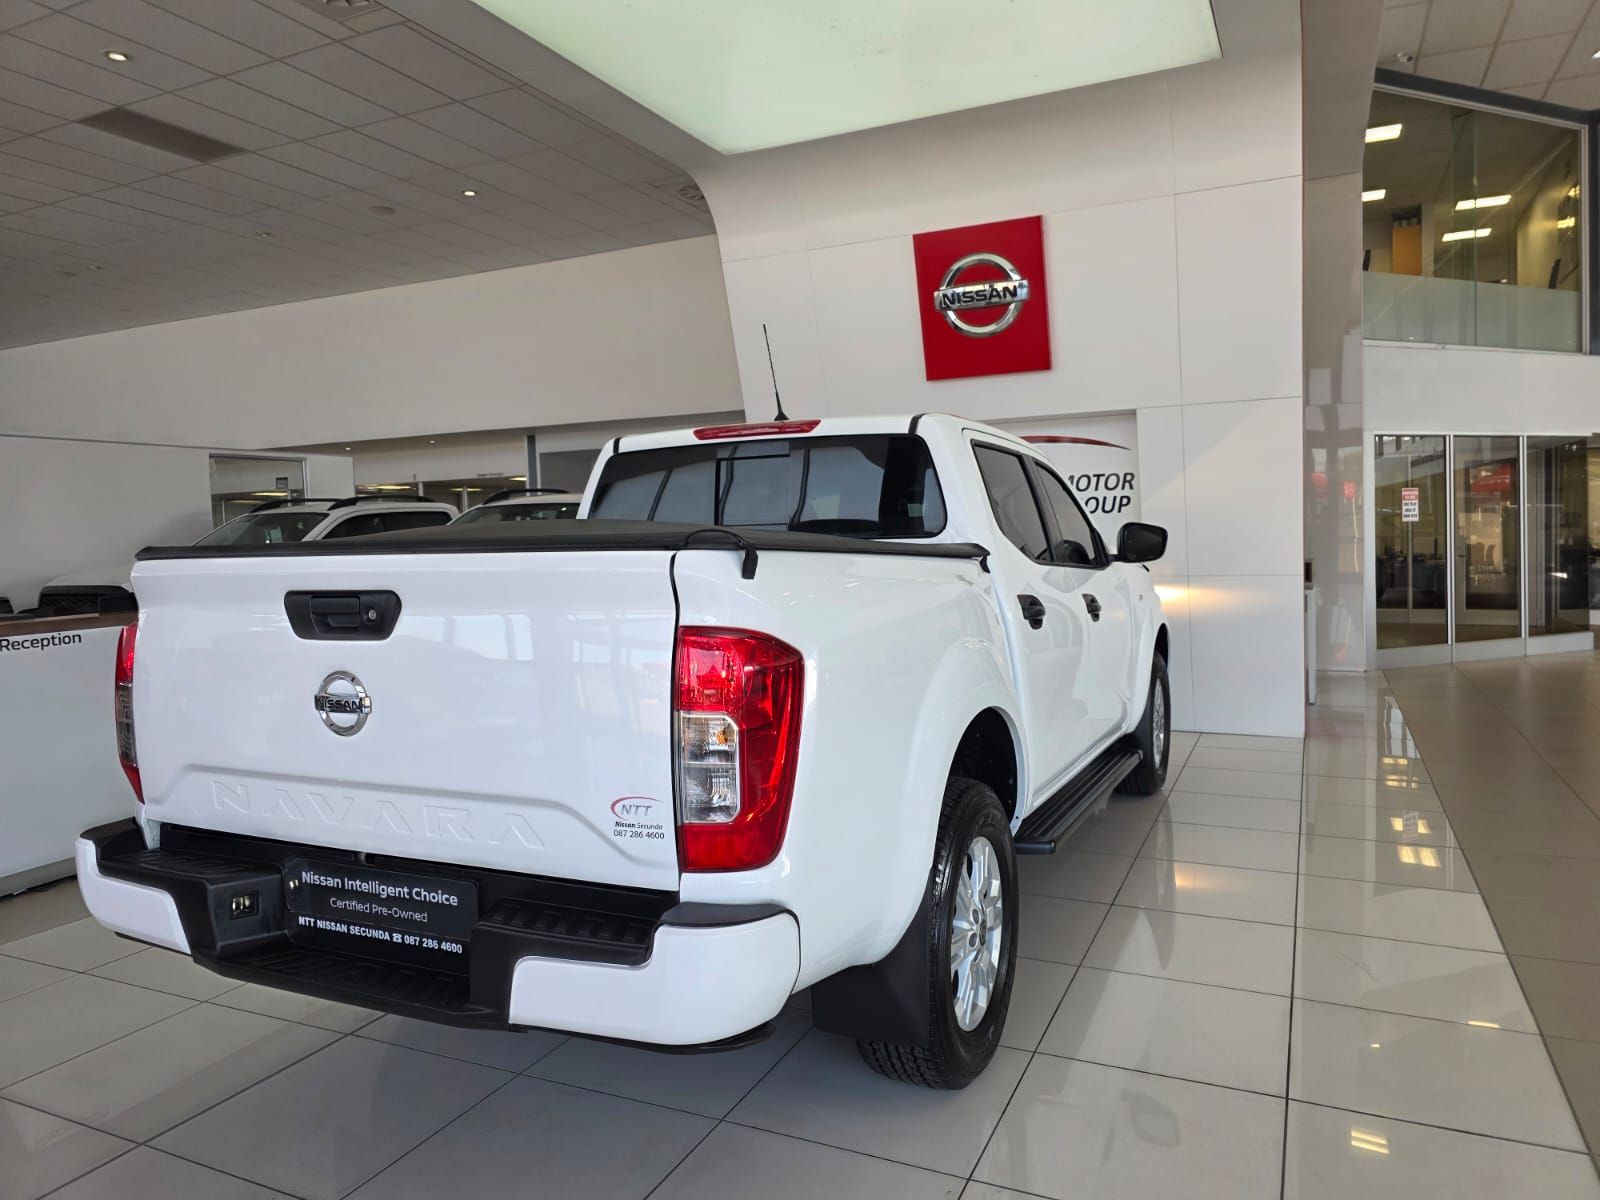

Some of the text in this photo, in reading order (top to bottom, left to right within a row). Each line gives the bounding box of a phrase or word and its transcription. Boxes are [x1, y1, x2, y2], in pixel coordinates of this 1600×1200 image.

[941, 284, 1018, 308] NISSAN
[0, 633, 81, 652] Reception
[315, 696, 362, 711] NISSAN
[212, 780, 545, 849] NAVARA
[620, 804, 653, 817] NTT
[613, 829, 665, 840] 087 286 4600
[615, 821, 636, 829] Nissan
[302, 871, 458, 906] Nissan Intelligent Choice
[330, 897, 428, 922] Certified Pre-Owned
[299, 915, 463, 954] NTT NISSAN SECUNDA 087 286 4600
